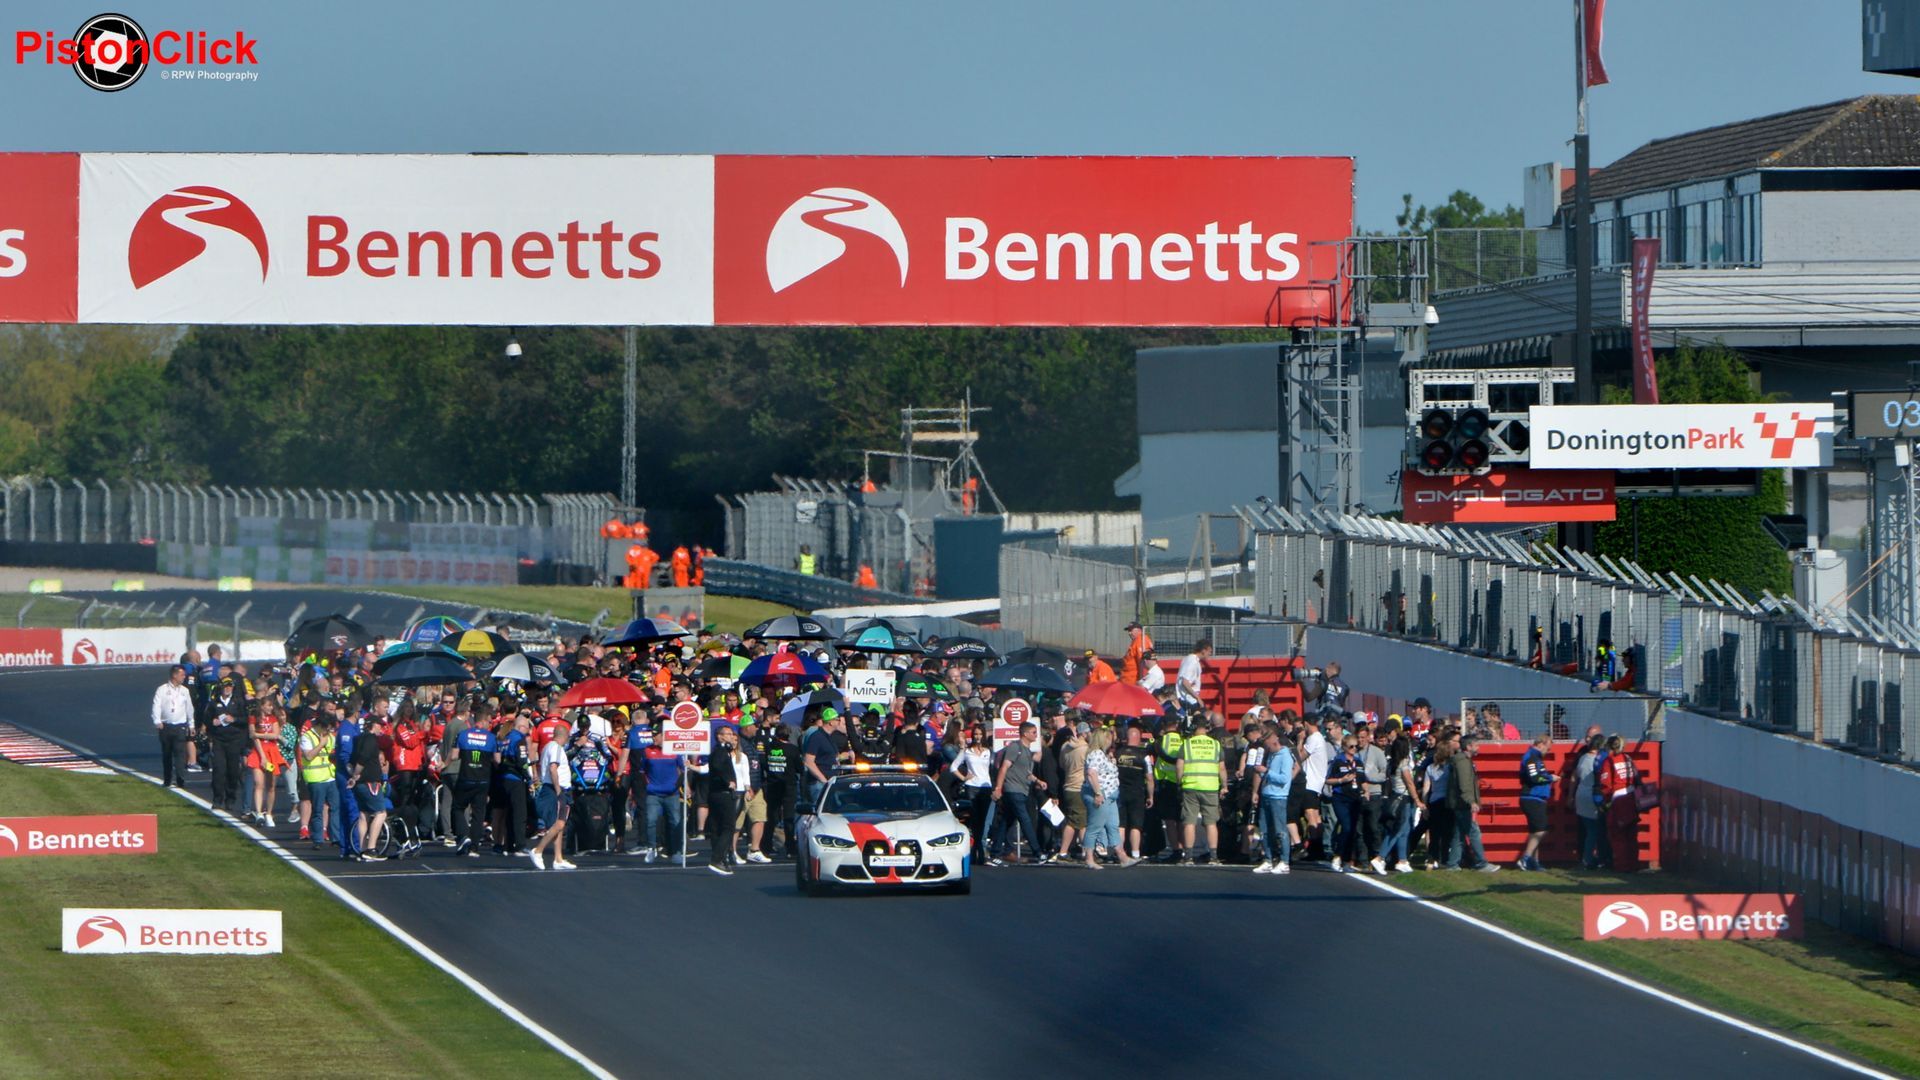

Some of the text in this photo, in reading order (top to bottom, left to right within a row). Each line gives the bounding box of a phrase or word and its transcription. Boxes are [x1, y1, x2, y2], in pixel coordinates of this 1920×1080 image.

[307, 216, 661, 279] Bennetts
[945, 218, 1300, 282] Bennetts
[1883, 400, 1920, 428] 03
[1547, 426, 1744, 456] DoningtonPark
[1414, 488, 1605, 504] OMOLOGATO
[852, 687, 888, 697] MINS
[865, 676, 876, 687] 4
[1011, 711, 1022, 721] 3
[28, 828, 145, 851] Bennetts
[1659, 909, 1790, 933] Bennetts
[139, 925, 268, 947] Bennetts
